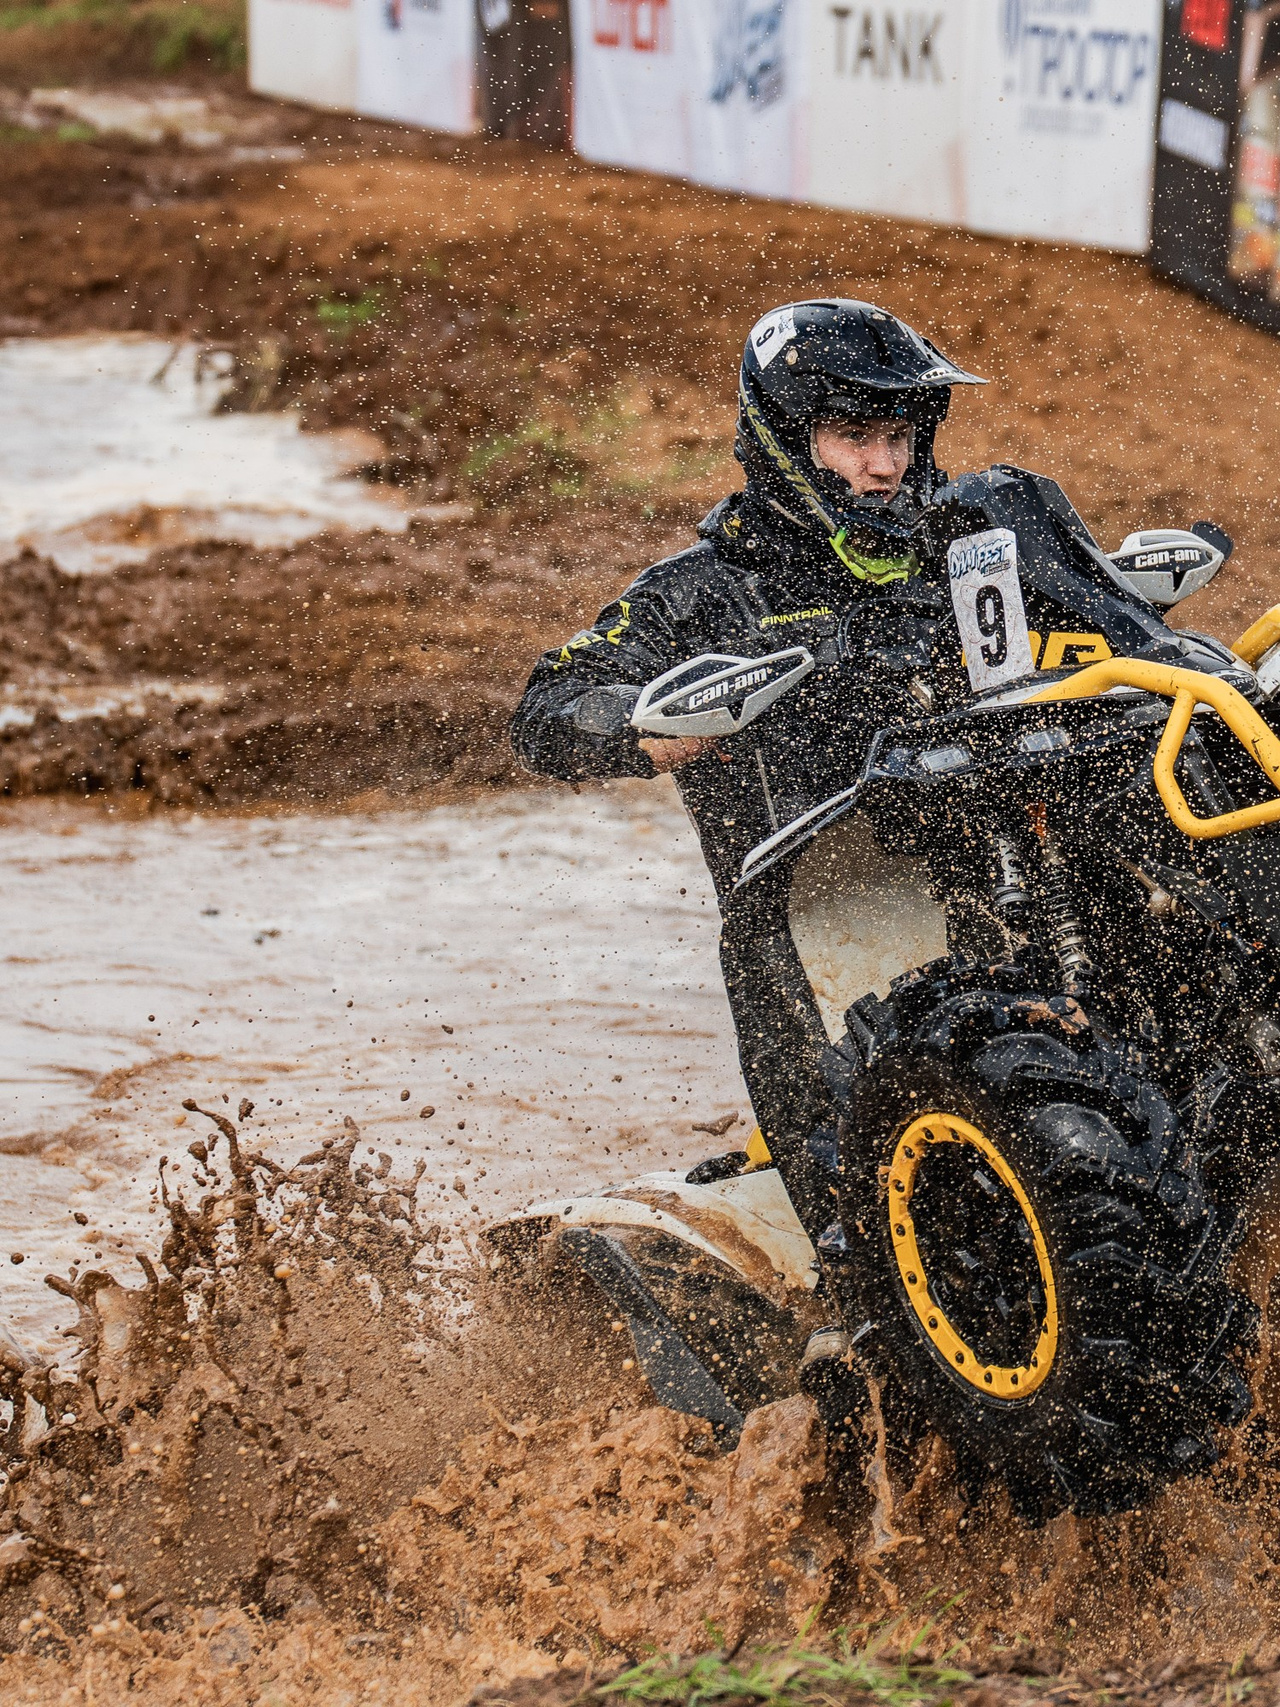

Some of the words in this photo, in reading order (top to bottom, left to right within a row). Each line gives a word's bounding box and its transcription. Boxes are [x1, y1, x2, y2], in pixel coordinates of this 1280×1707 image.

[830, 4, 945, 84] TANK
[1135, 549, 1200, 569] can-am
[761, 606, 833, 626] FINNTRAIL
[975, 585, 1008, 668] 9
[688, 667, 767, 711] can-am
